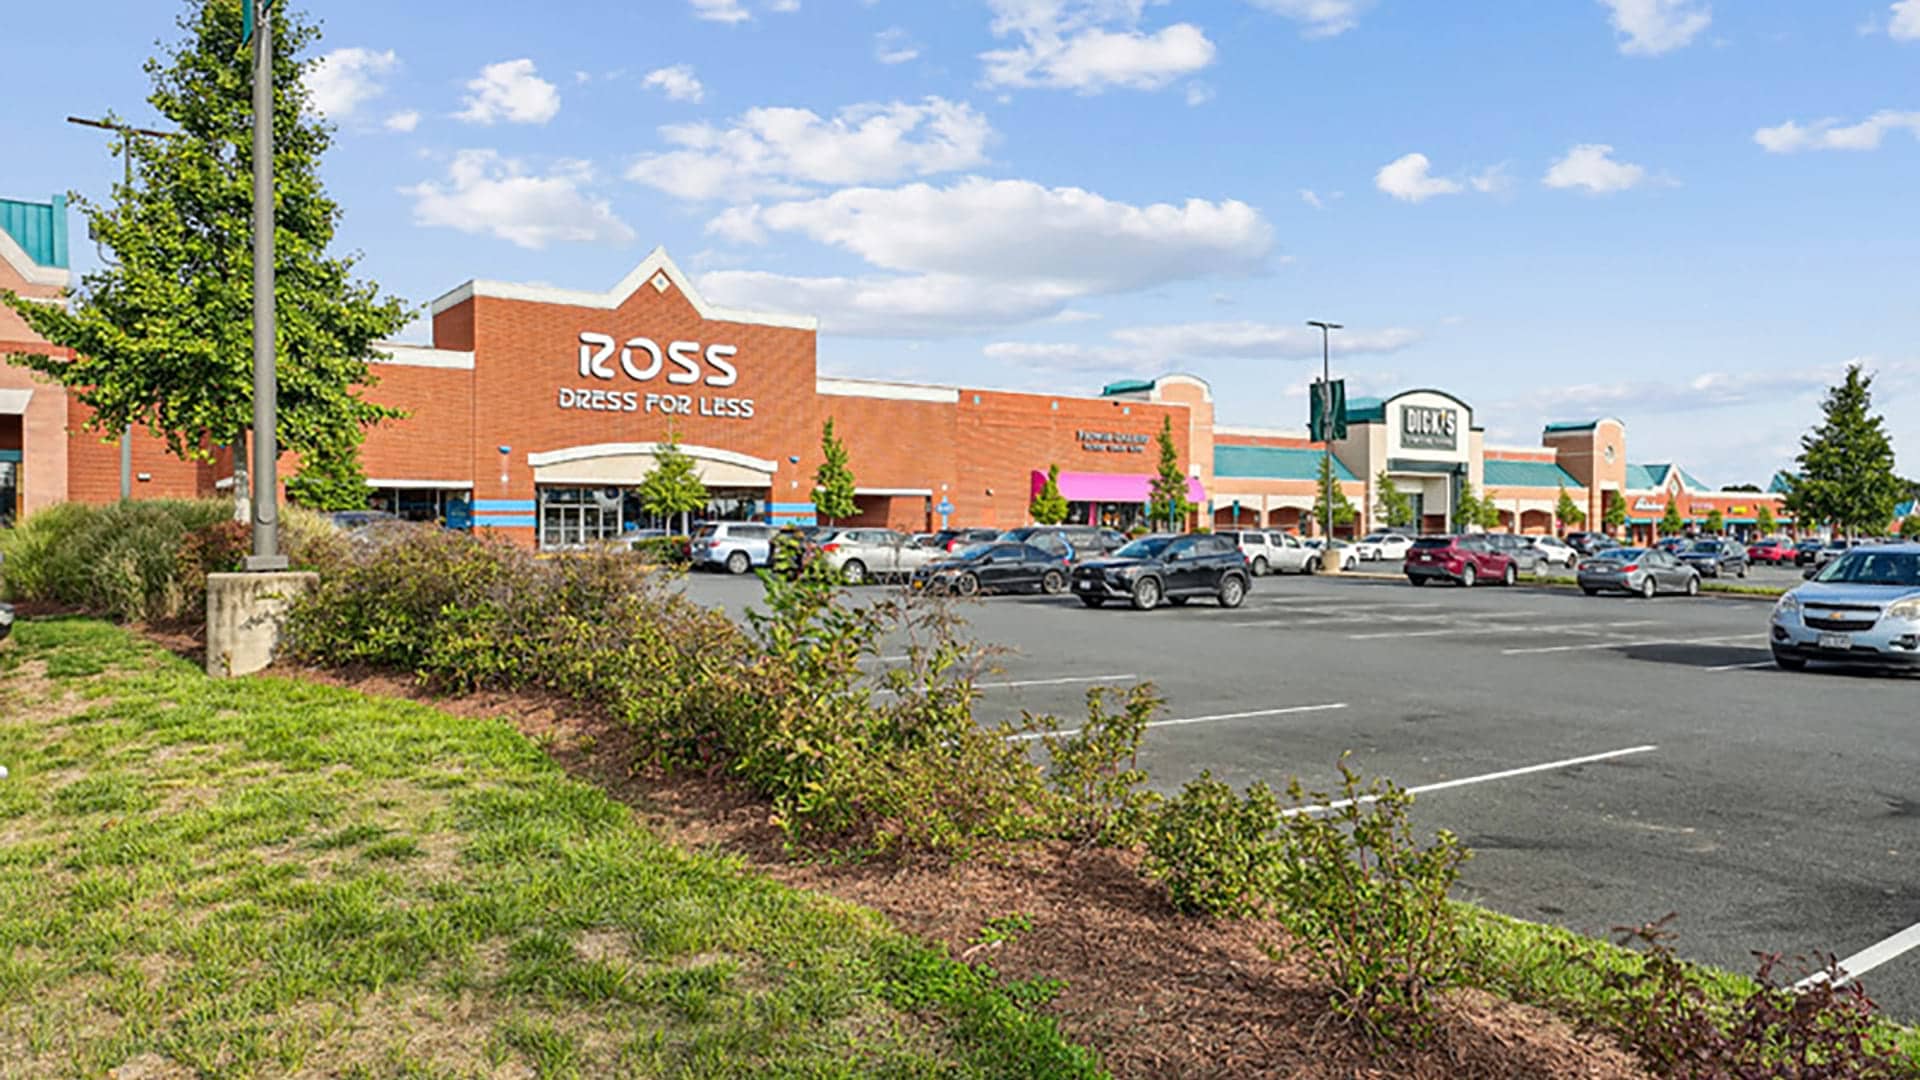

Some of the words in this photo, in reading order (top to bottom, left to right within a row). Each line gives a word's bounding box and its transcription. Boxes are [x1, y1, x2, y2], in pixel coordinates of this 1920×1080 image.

[579, 331, 738, 387] ROSS
[559, 387, 638, 412] DRESS
[645, 393, 692, 415] FOR
[700, 396, 755, 419] LESS
[1405, 408, 1455, 436] DICK'S
